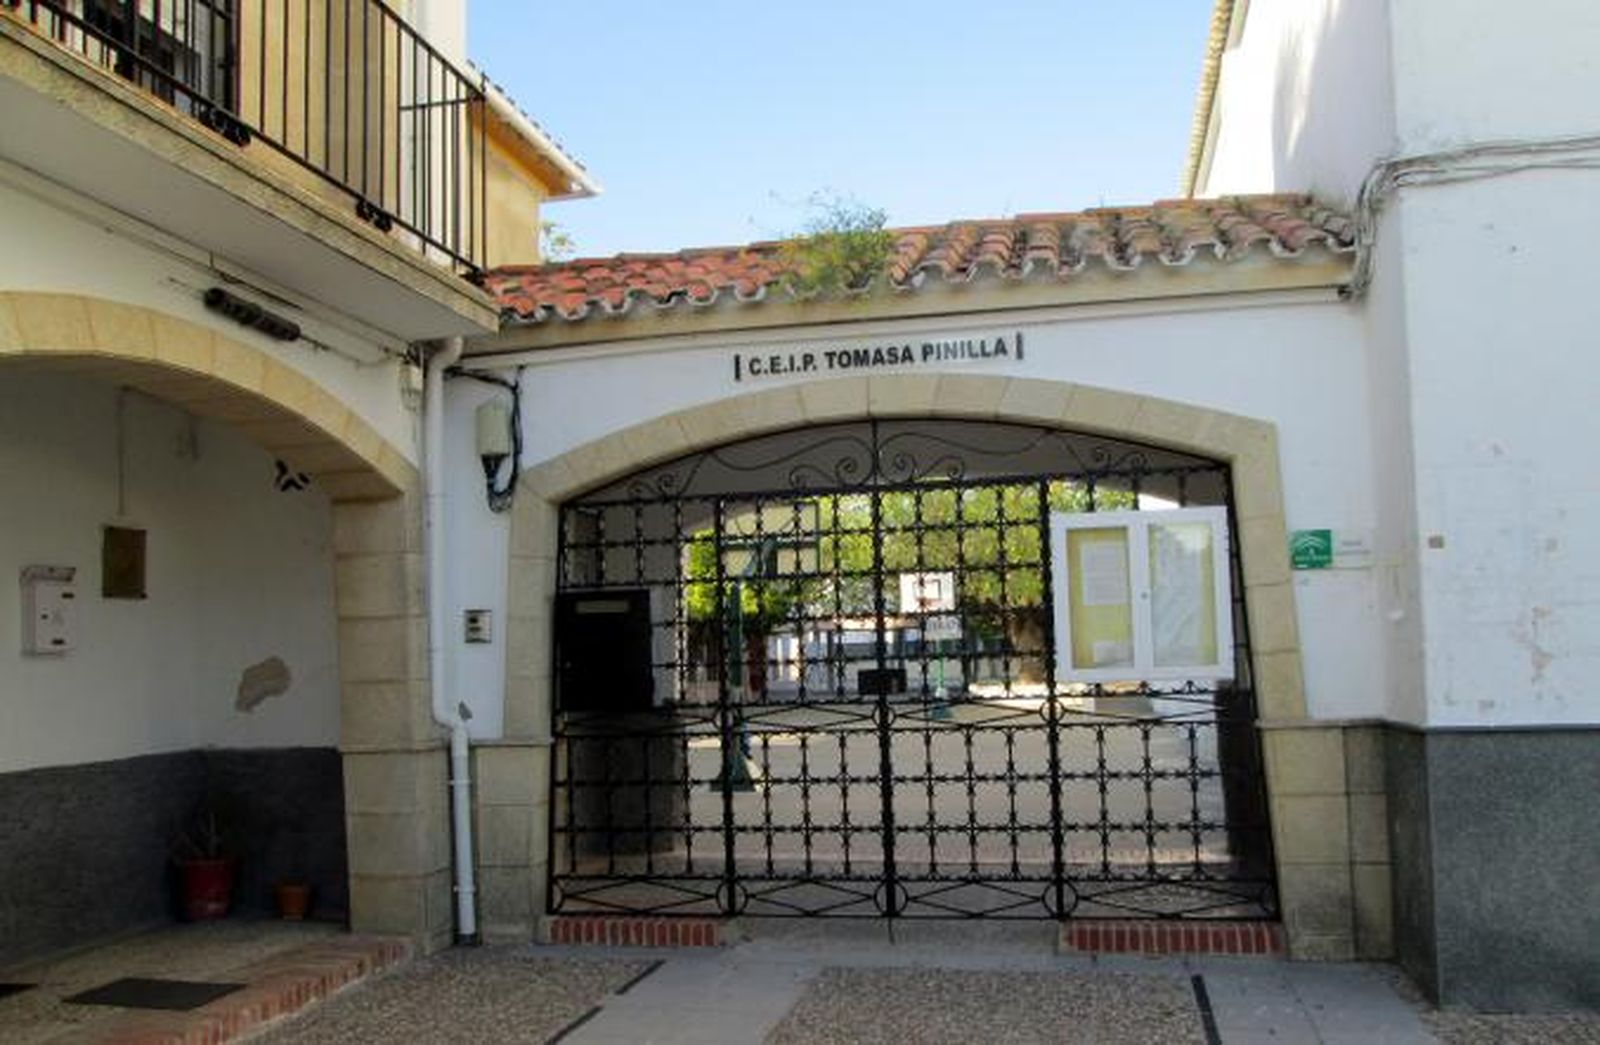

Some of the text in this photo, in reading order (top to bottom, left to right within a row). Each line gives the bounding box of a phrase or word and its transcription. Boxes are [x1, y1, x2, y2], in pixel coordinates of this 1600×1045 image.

[749, 337, 1008, 376] C.E.I.P. TOMASA PINILLA
